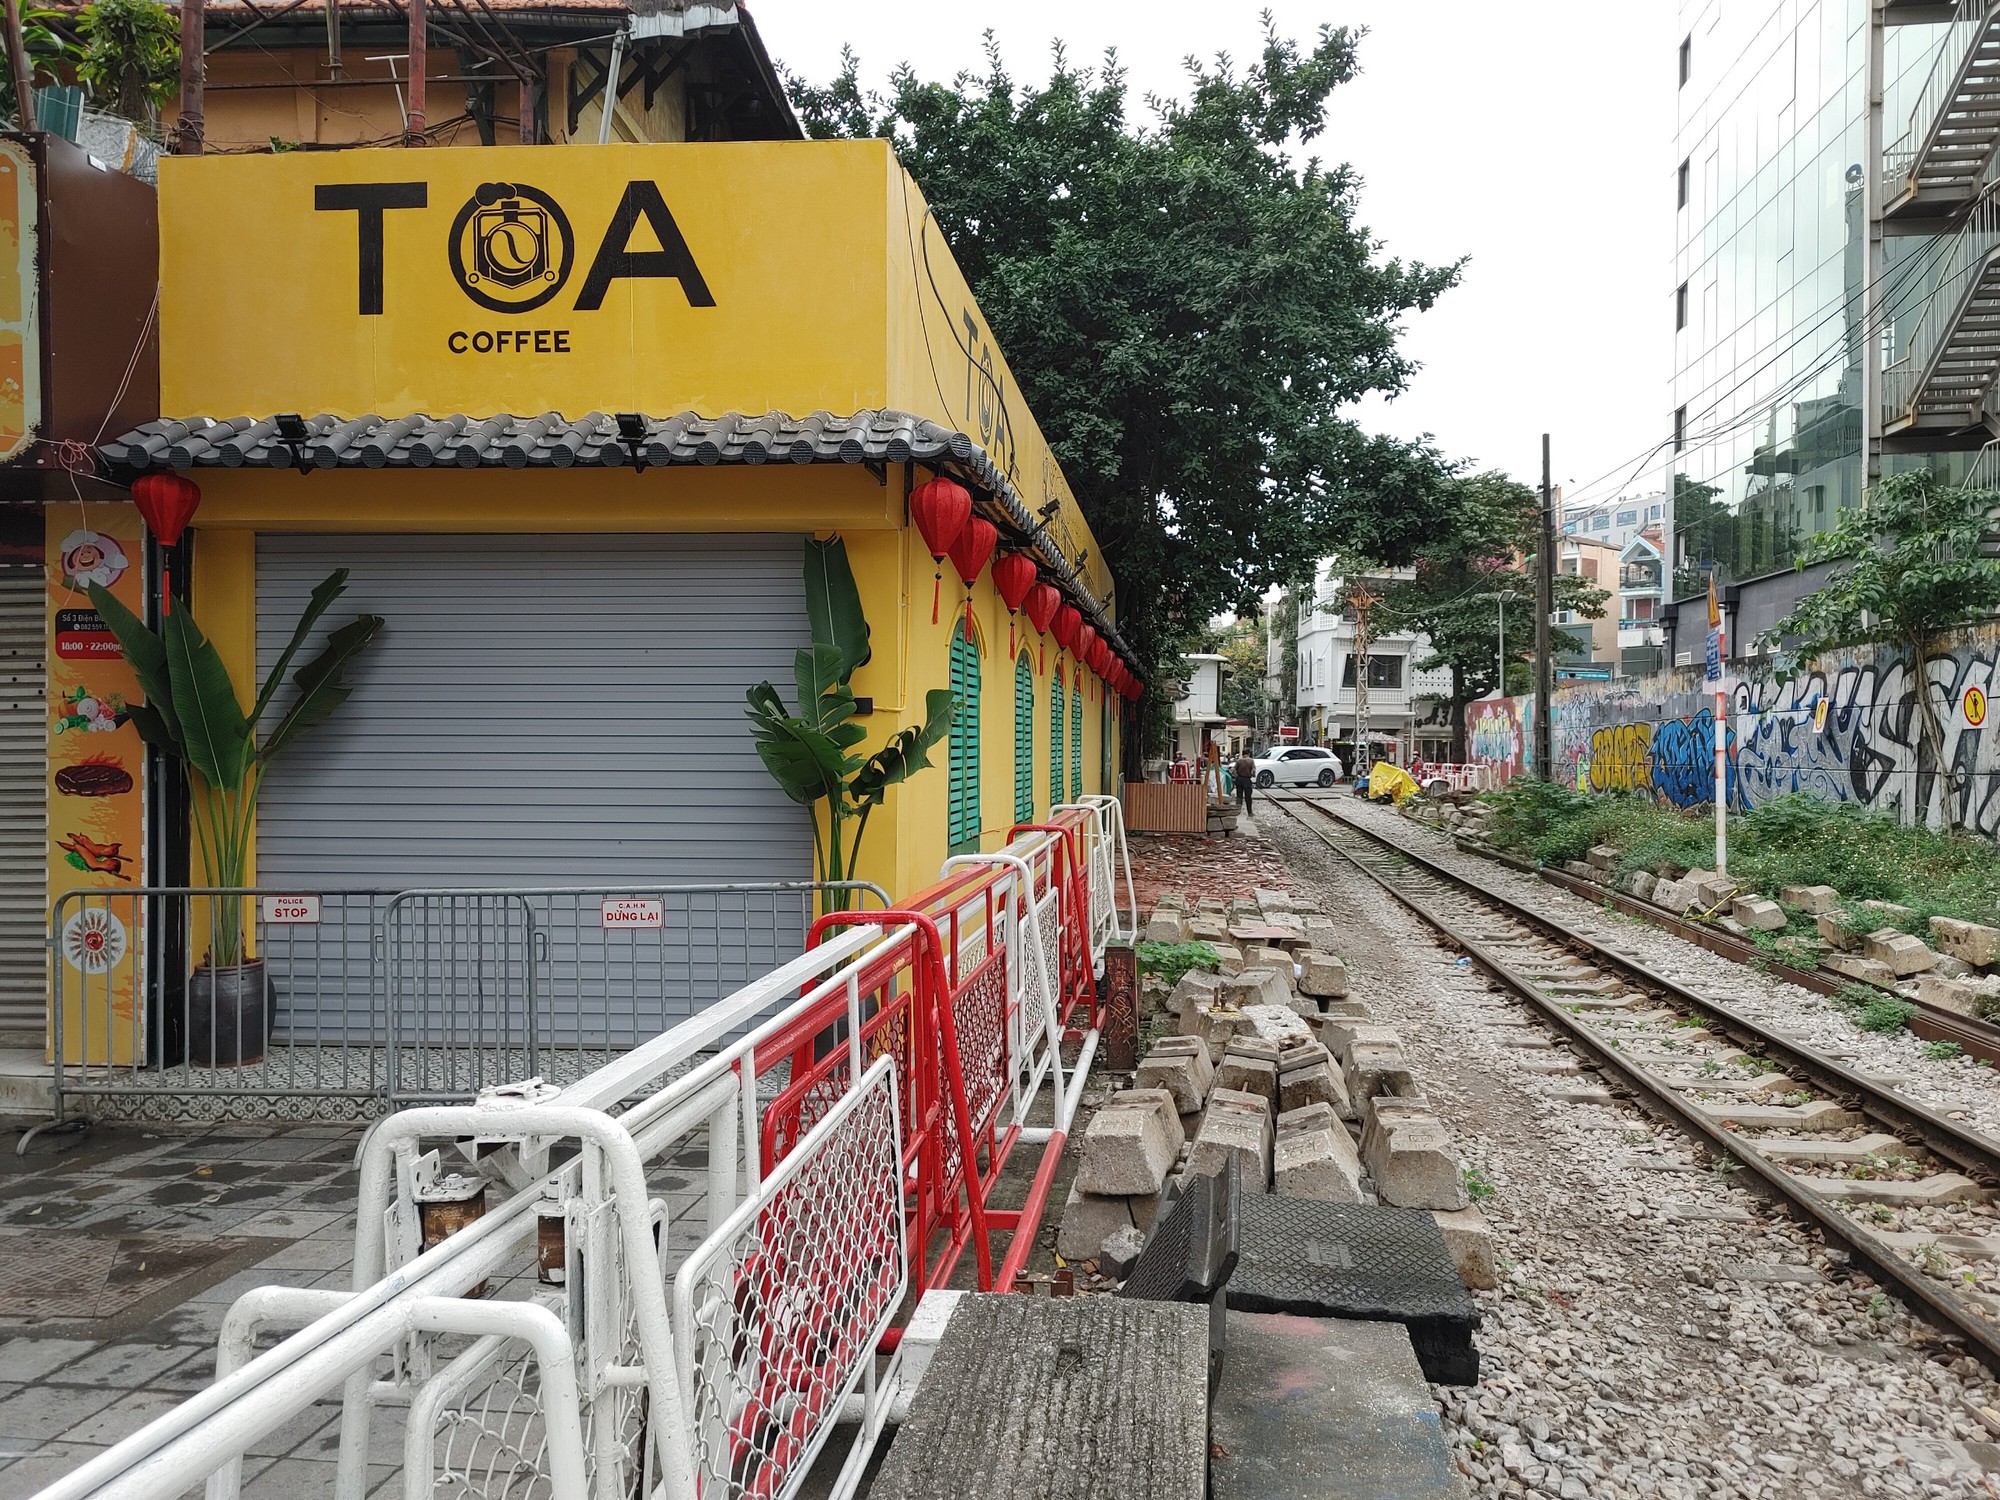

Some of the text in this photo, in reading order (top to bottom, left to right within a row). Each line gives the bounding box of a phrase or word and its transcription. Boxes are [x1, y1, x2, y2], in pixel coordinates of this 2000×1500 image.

[314, 180, 717, 316] TOA
[448, 330, 571, 354] COFFEE
[62, 613, 71, 621] Số
[72, 614, 77, 622] 3
[78, 614, 93, 623] Điện
[61, 642, 83, 650] 18:00
[274, 908, 308, 917] STOP
[606, 909, 659, 923] DỪNG LẠI
